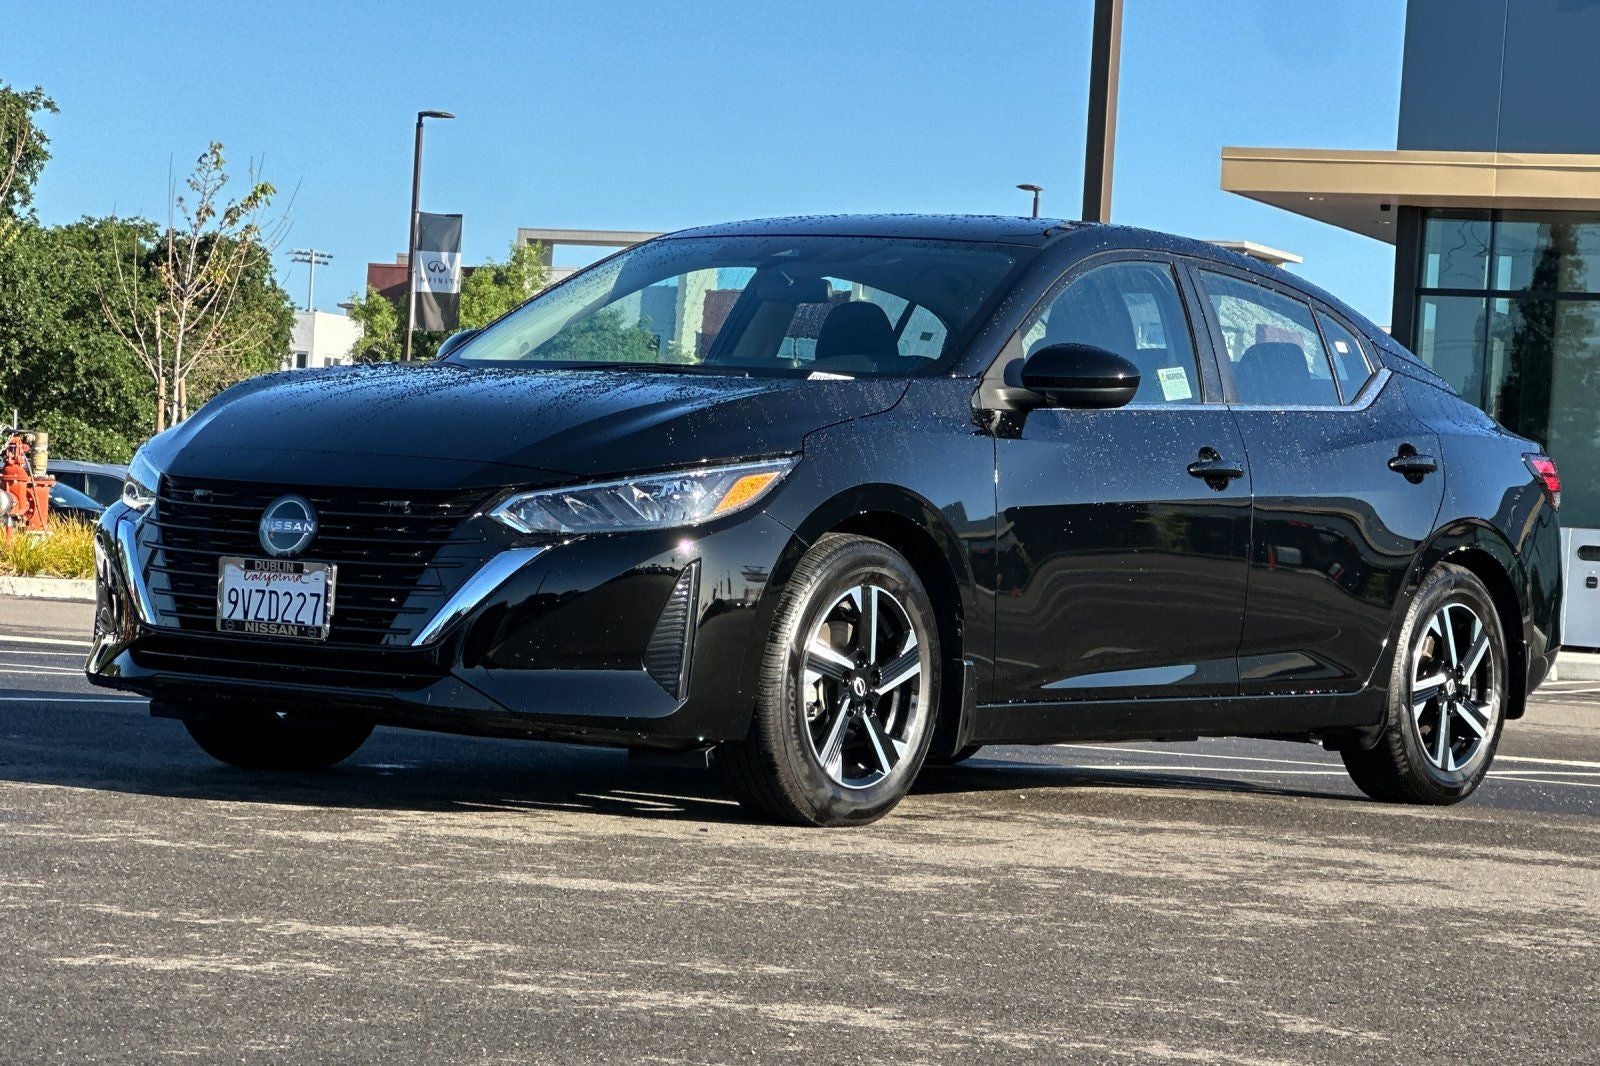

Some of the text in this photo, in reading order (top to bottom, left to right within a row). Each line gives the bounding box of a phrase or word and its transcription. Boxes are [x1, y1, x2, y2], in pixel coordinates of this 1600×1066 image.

[262, 519, 314, 531] NISSAN
[254, 560, 294, 573] DUBLIN
[244, 571, 309, 587] California
[227, 587, 322, 626] 9VZD227
[244, 621, 299, 636] NISSAN
